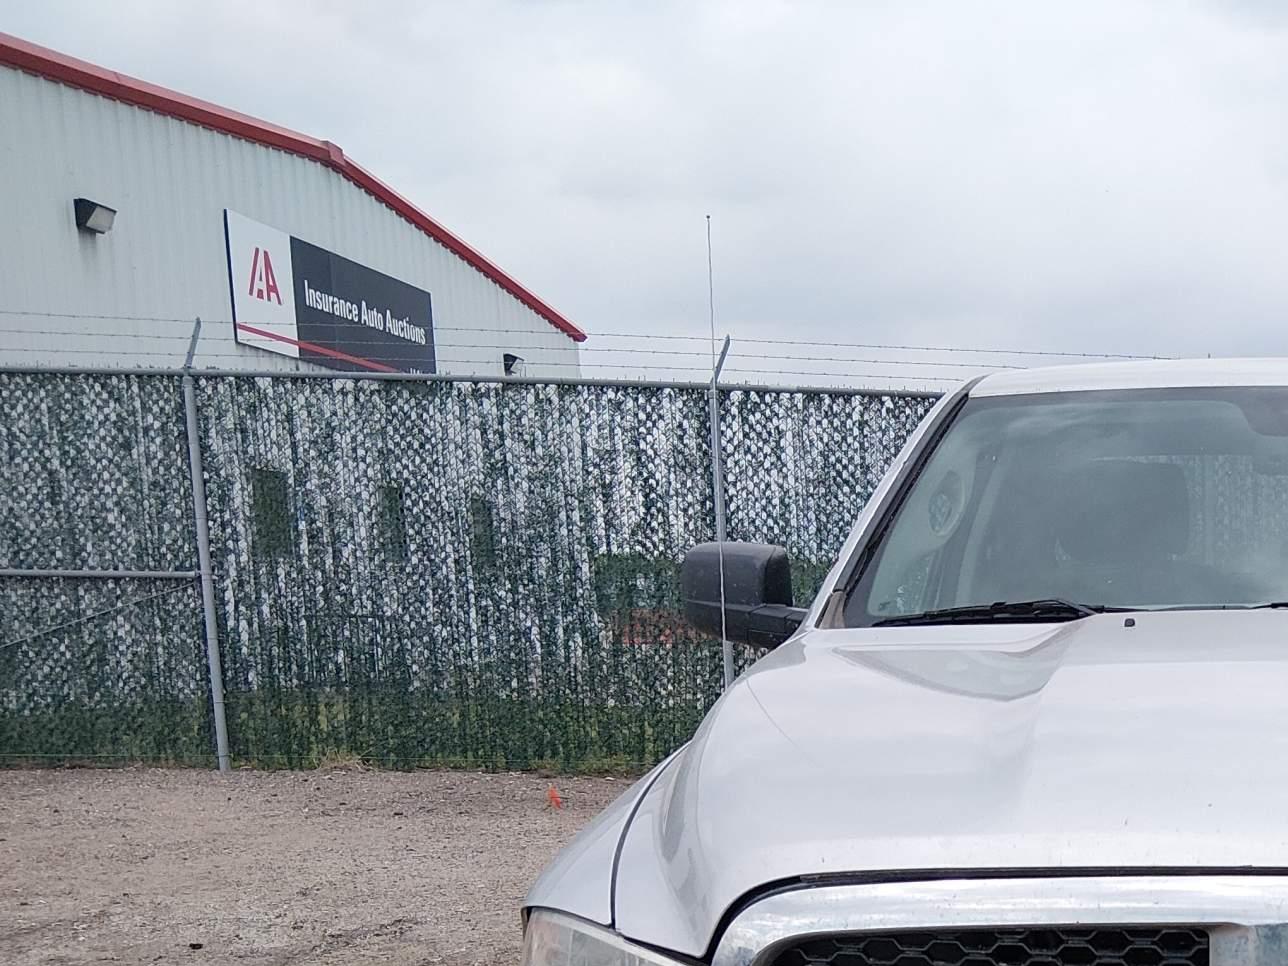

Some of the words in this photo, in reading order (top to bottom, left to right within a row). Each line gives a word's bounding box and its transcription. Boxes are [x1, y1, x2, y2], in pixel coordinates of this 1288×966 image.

[303, 279, 359, 322] Insurance
[361, 300, 384, 332] Auto
[386, 309, 426, 345] Auctions
